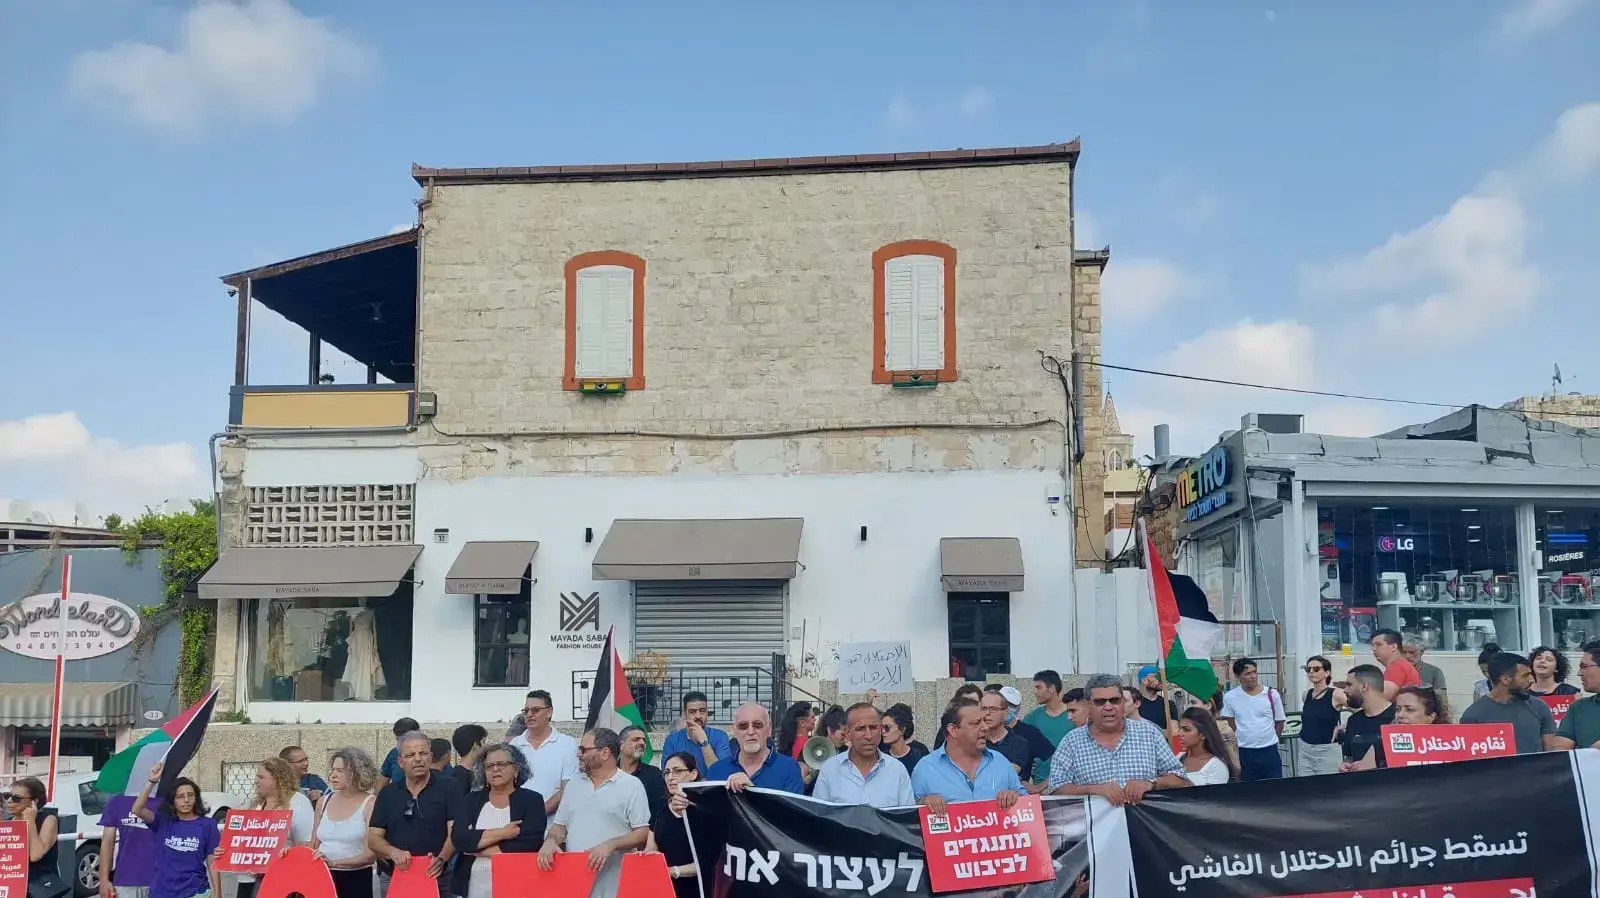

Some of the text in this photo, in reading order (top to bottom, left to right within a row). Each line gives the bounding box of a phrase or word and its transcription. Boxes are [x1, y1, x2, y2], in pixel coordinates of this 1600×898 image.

[1176, 446, 1228, 508] METRO
[1397, 538, 1414, 550] LG
[1418, 735, 1466, 754] الاحتلال
[243, 818, 270, 831] الاحتلال
[954, 812, 999, 833] الاحتلال
[230, 835, 279, 848] מתנגדים
[943, 832, 1032, 857] מתנגדים
[229, 851, 271, 865] לכיבוש
[723, 842, 780, 885] את
[953, 853, 1028, 879] לכיבוש
[1169, 831, 1528, 891] تسقط جرائم الاحتلال الفاشي
[793, 852, 924, 896] לעצור
